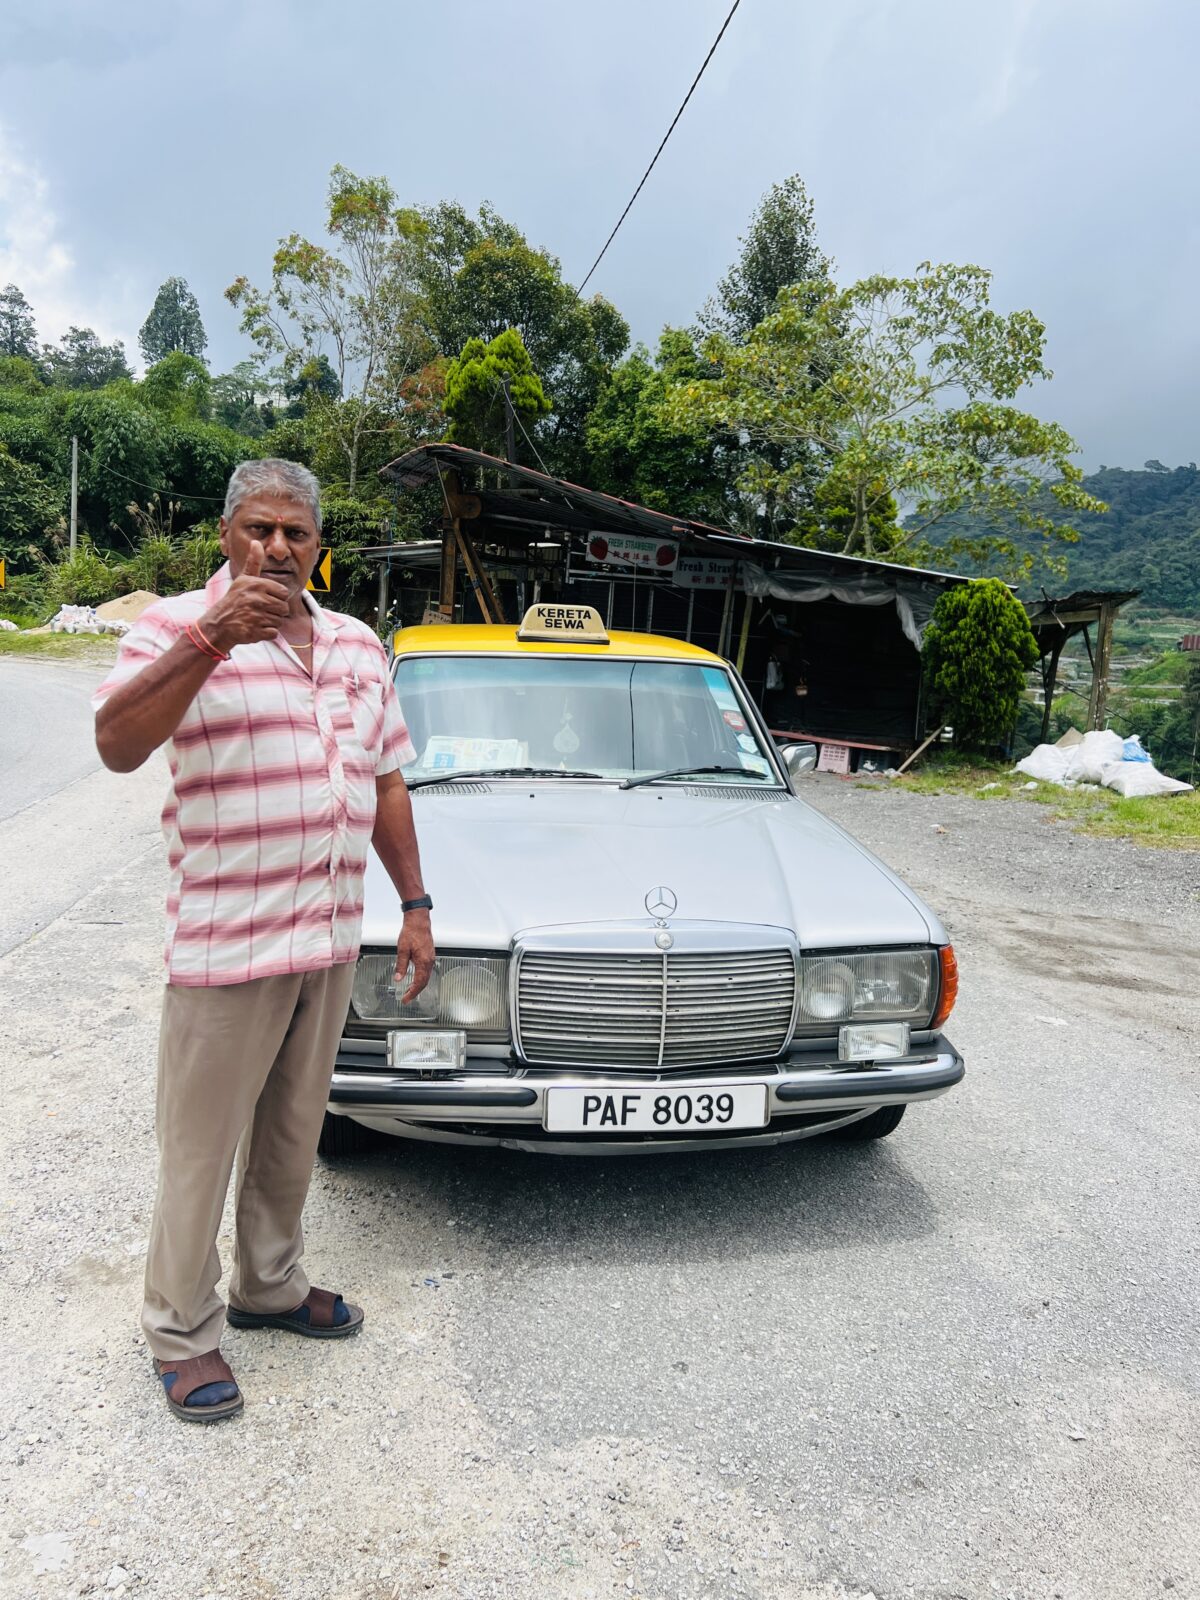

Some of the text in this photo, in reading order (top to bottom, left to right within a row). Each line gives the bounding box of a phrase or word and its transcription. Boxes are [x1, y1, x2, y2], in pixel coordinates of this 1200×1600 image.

[678, 560, 704, 572] Fresh
[537, 607, 592, 620] KERETA
[544, 618, 585, 630] SEWA
[582, 1093, 735, 1126] PAF 8039
